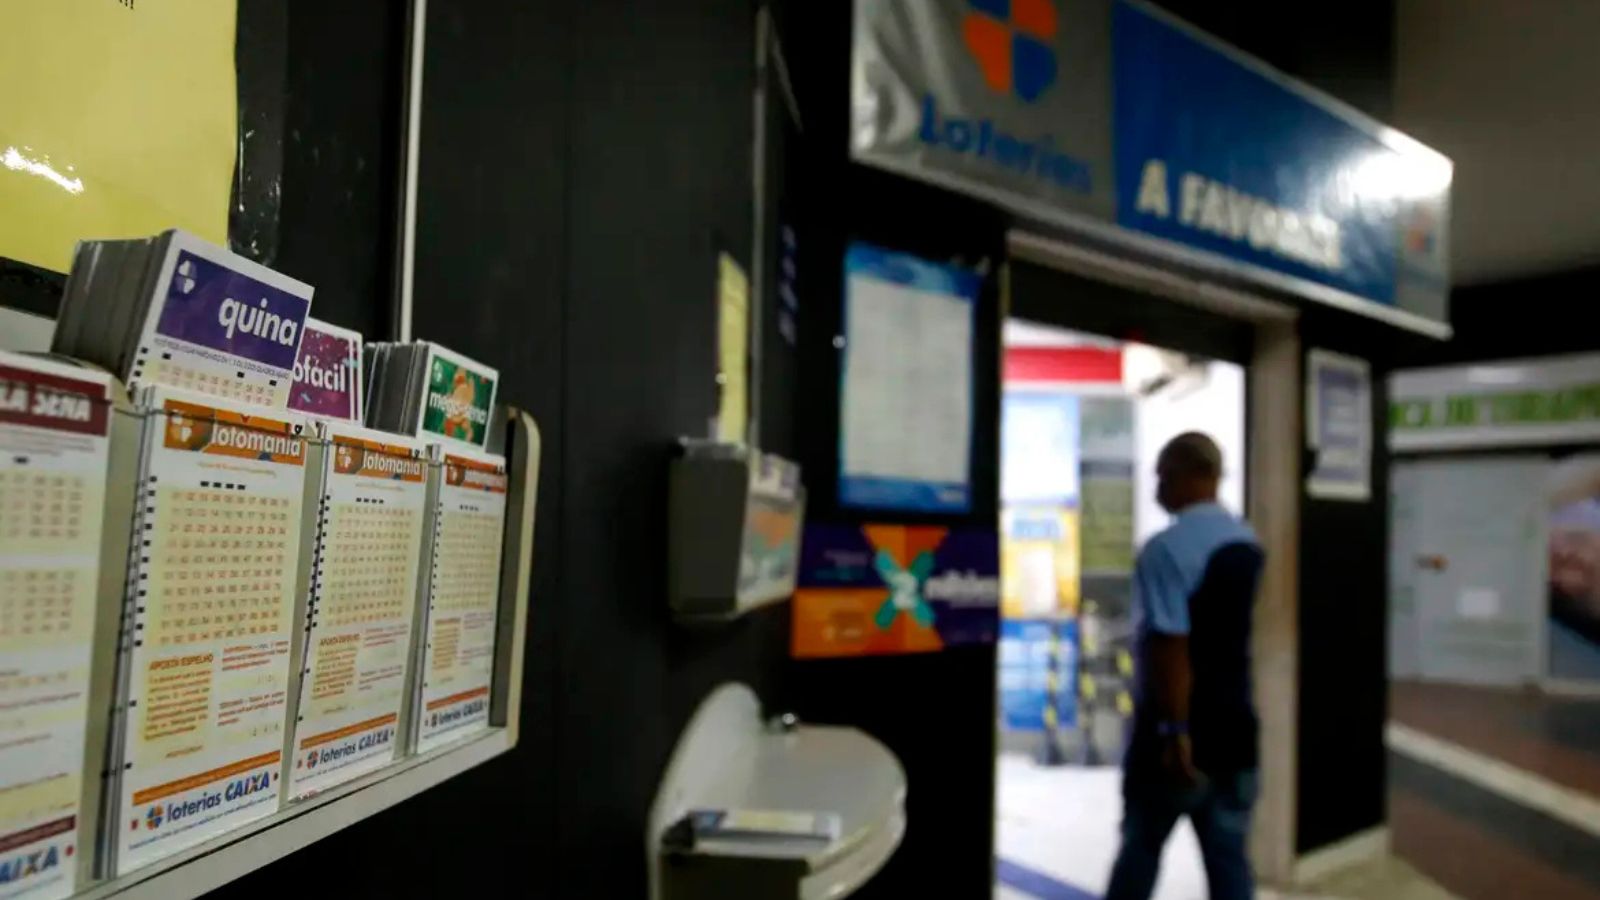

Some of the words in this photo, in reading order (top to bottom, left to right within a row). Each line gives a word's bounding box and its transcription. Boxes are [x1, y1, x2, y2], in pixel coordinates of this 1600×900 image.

[1136, 159, 1169, 217] A
[218, 297, 298, 346] quina
[211, 423, 300, 457] lotomania
[363, 450, 422, 476] lotomania
[319, 742, 356, 765] loterias
[358, 728, 388, 754] CAIXA
[167, 791, 222, 822] loterias
[225, 772, 270, 801] CAIXA
